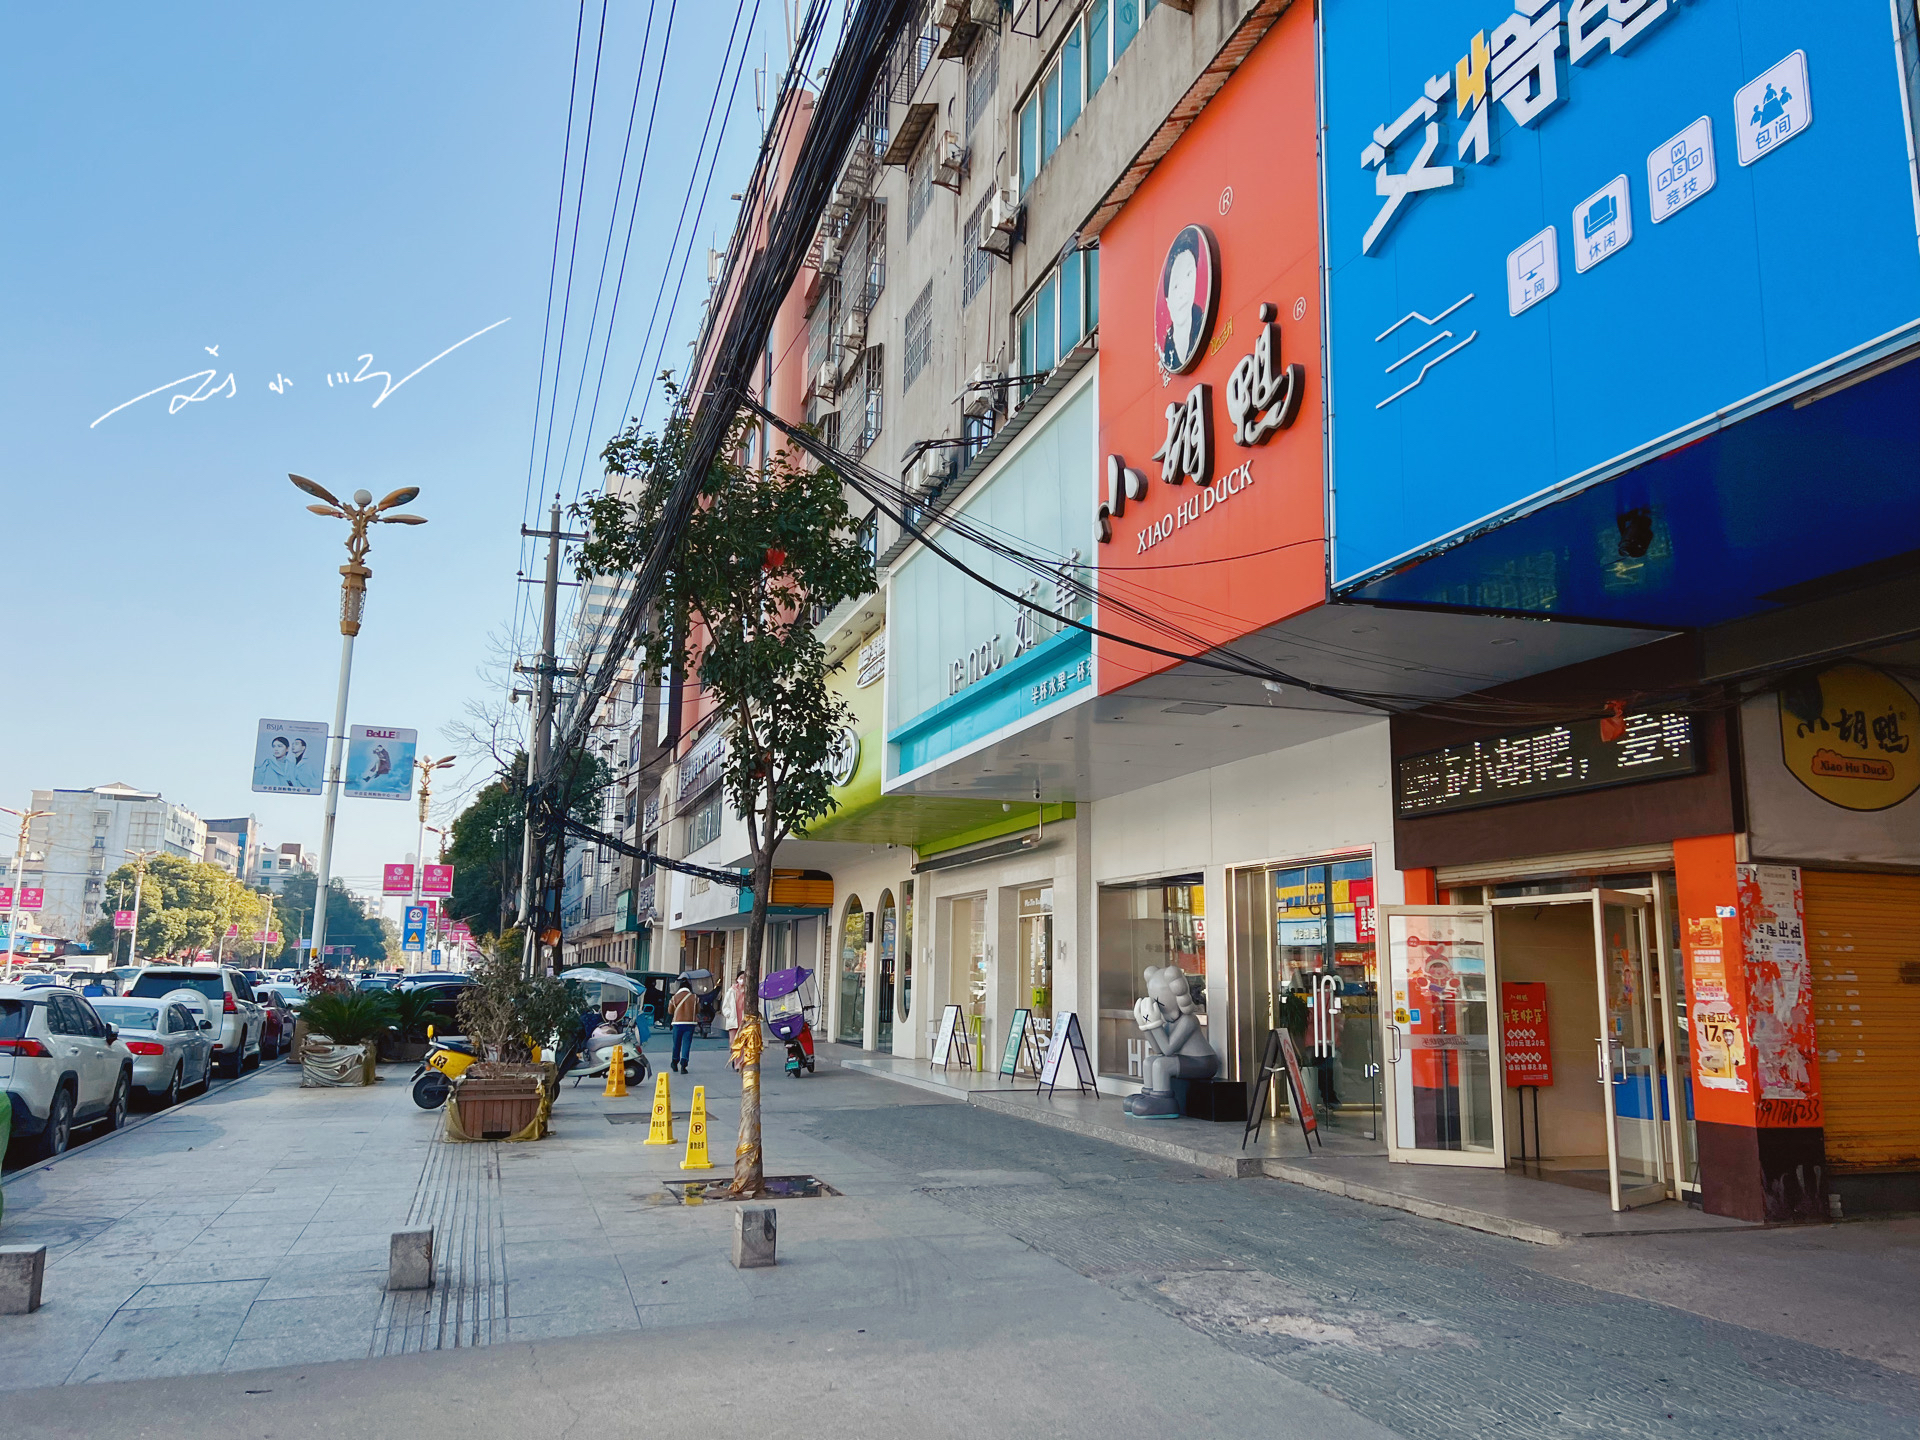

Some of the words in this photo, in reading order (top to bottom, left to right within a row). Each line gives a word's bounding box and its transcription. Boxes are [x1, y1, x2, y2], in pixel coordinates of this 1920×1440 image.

[1755, 114, 1792, 150] 包间
[1666, 176, 1698, 210] 竞技
[1588, 230, 1617, 261] 休闲
[1521, 277, 1546, 305] 上网
[1094, 301, 1305, 544] 小胡鸭
[1136, 512, 1174, 555] XIAO
[1176, 491, 1202, 530] HU
[1203, 459, 1254, 514] DUCK
[1797, 704, 1910, 754] 小胡鸭
[1820, 760, 1843, 772] Xiao
[1845, 762, 1860, 773] Hu
[1862, 764, 1888, 776] Duck
